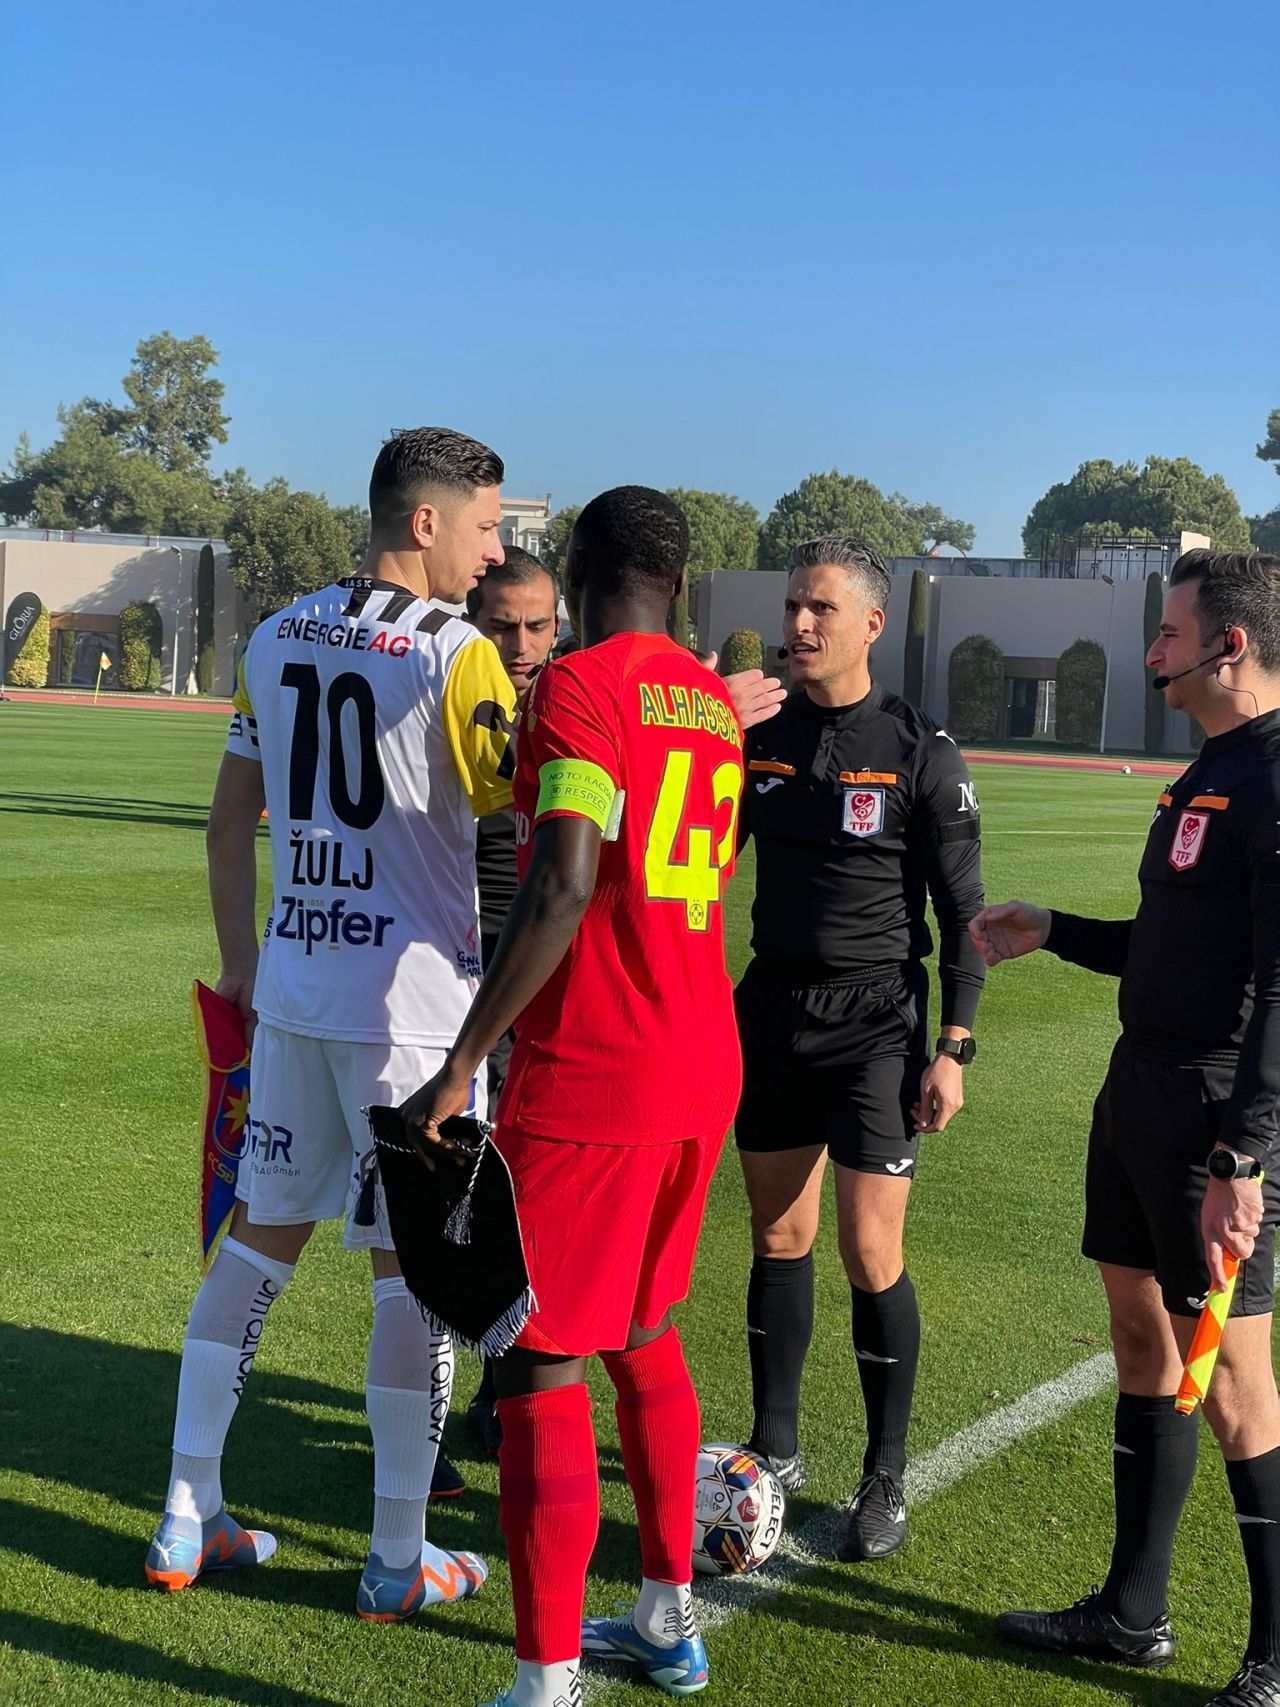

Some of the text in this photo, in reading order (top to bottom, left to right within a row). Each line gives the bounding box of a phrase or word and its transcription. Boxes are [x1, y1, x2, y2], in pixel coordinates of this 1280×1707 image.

[639, 683, 742, 750] ALHASSA
[280, 662, 385, 831] 10
[548, 771, 564, 782] NO
[566, 771, 581, 780] TO
[565, 786, 607, 811] RESPECT
[644, 748, 742, 932] 42
[850, 821, 874, 832] TFF
[289, 829, 374, 891] ŽULJ
[1175, 850, 1192, 863] TFF
[276, 895, 395, 956] Zipfer
[208, 1152, 235, 1184] FCSB
[250, 1279, 278, 1315] LUC
[760, 1480, 781, 1550] SELECT
